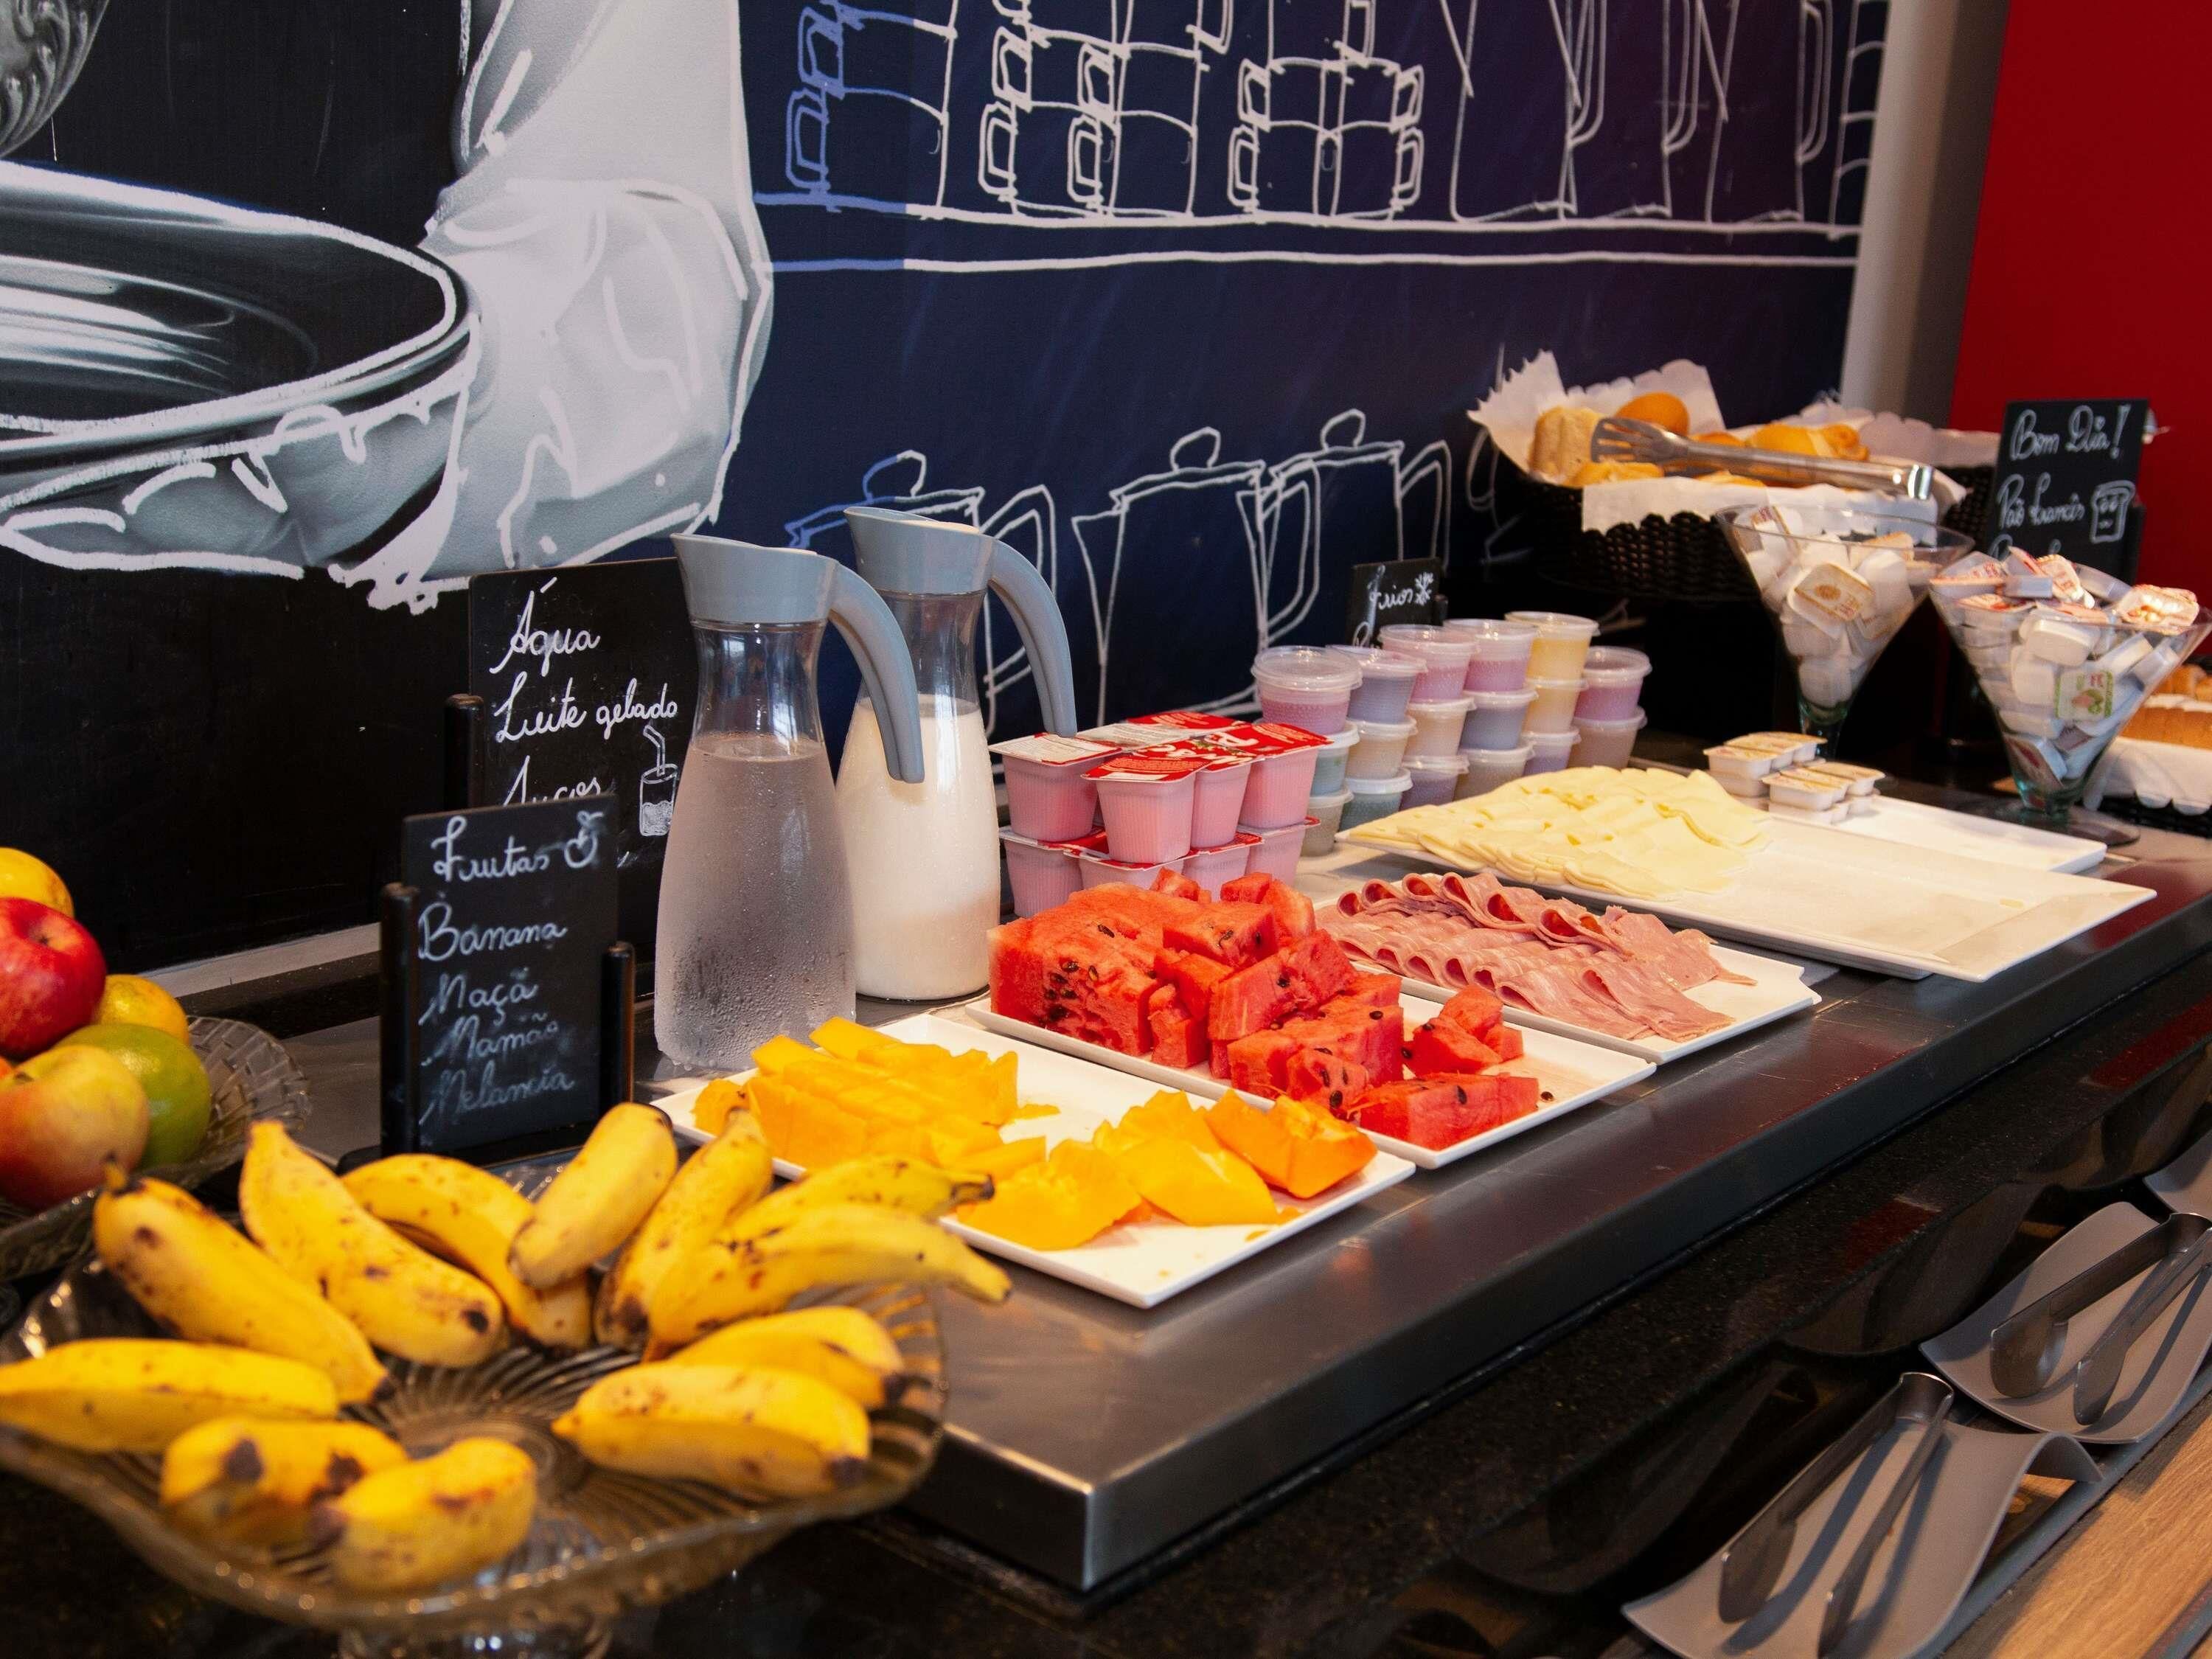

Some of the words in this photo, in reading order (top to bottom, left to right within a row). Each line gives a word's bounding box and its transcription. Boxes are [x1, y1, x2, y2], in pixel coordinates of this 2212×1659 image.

[2008, 408, 2060, 461] Bom
[1996, 473, 2025, 529] Pão
[489, 577, 601, 677] Água
[494, 671, 587, 743] Leite
[596, 678, 678, 740] gelado
[431, 815, 550, 882] Frutas
[418, 900, 567, 961] Banana
[418, 967, 539, 1026] Maçã
[420, 1011, 559, 1067] Mamão
